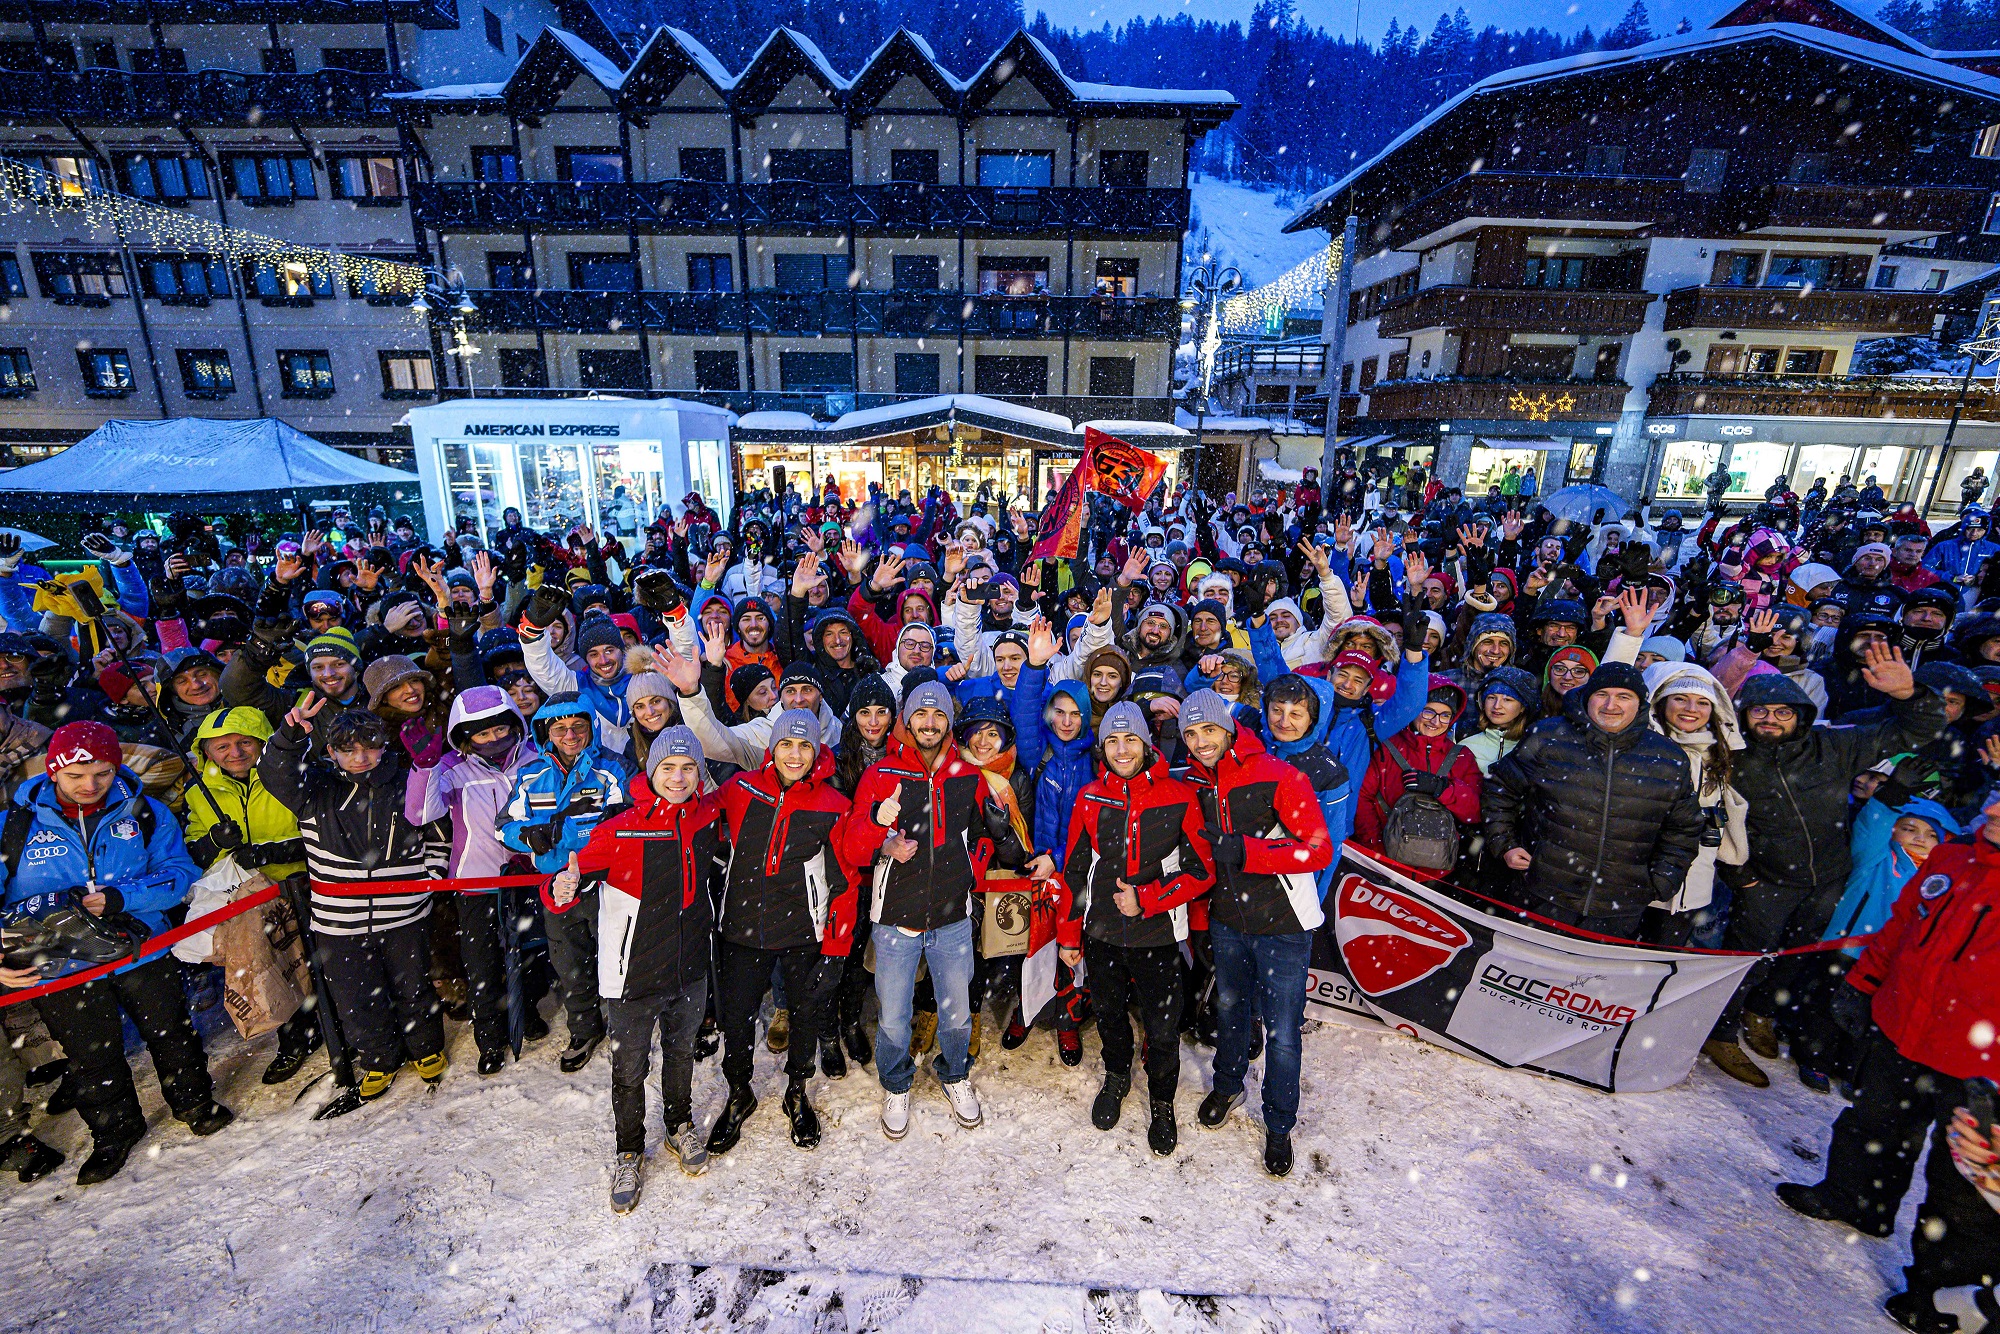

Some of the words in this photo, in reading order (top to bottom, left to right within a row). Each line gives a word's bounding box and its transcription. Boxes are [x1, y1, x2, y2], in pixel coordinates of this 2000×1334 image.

[463, 424, 545, 436] AMERICAN
[548, 424, 620, 437] EXPRESS
[1346, 652, 1371, 664] DUCATI
[49, 748, 94, 772] FILA
[1350, 885, 1457, 939] DUCATI
[1479, 986, 1531, 1010] DUCATI
[1538, 1008, 1574, 1025] CLUB
[1580, 1022, 1613, 1033] ROM
